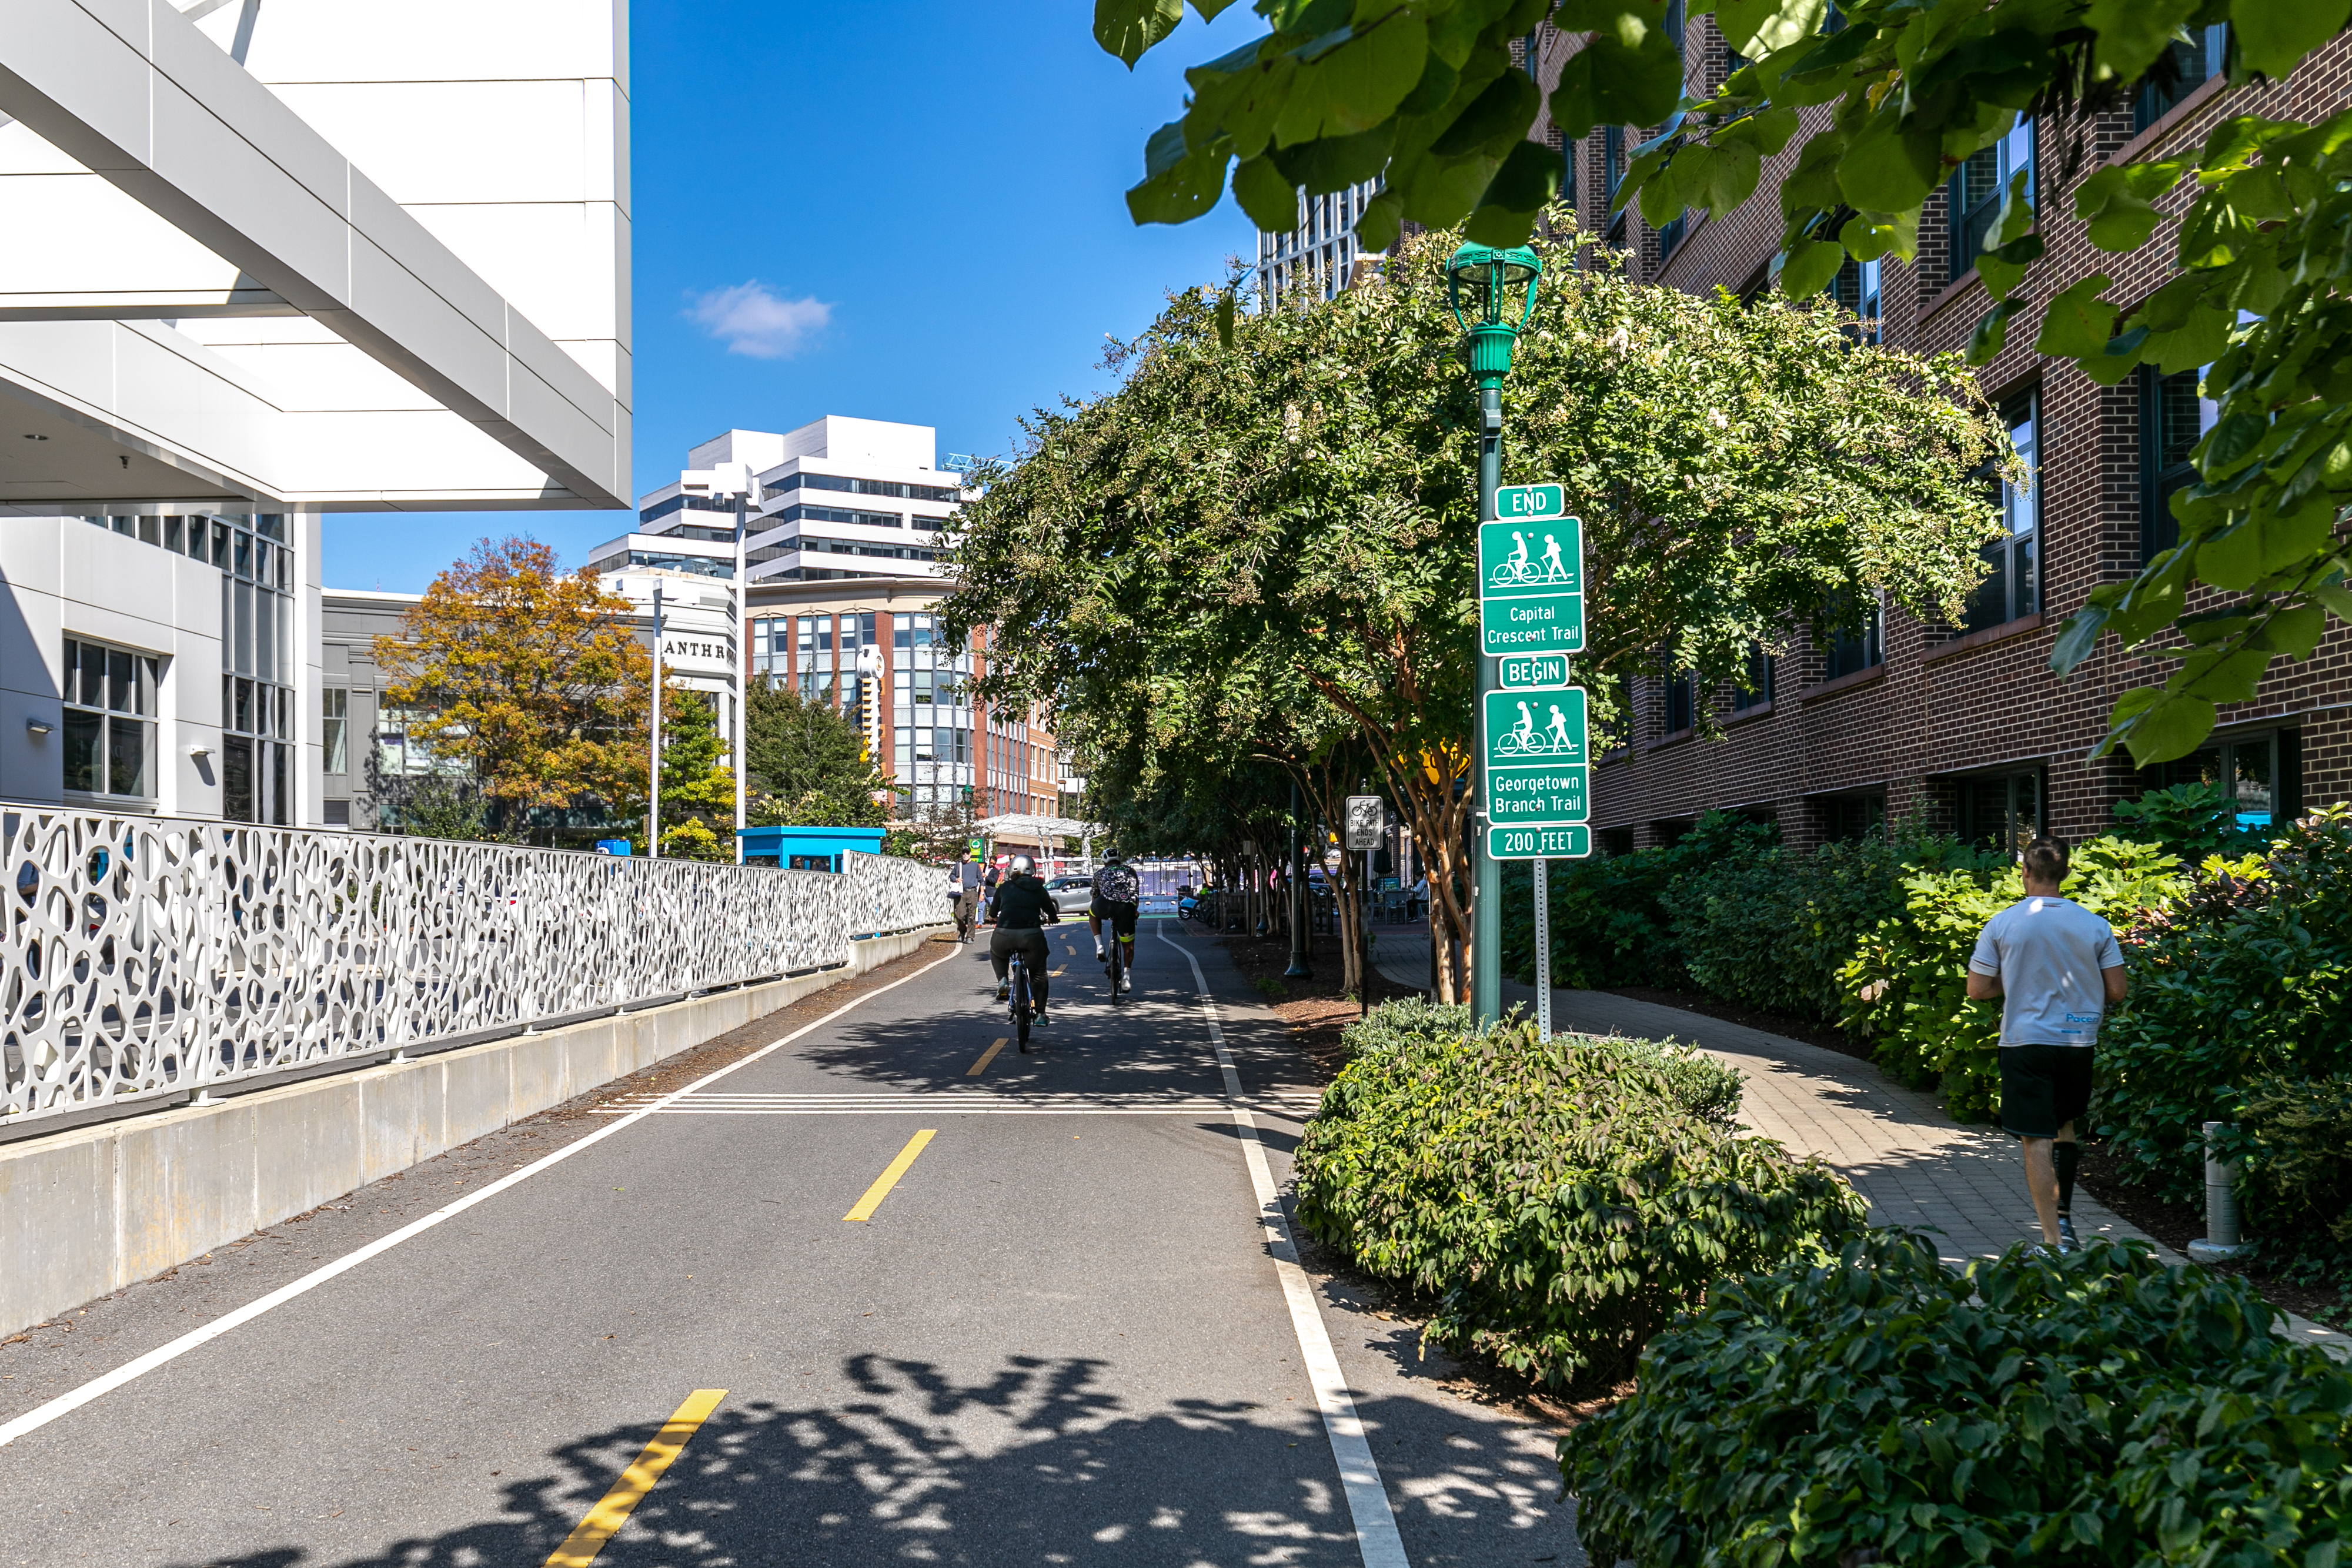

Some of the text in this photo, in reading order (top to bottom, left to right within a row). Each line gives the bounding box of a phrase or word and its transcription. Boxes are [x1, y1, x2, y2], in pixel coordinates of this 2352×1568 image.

[1512, 492, 1546, 512] END
[1510, 606, 1555, 624] Capital
[1488, 626, 1579, 644] Crescent Trail
[1509, 661, 1560, 682] BEGIN
[1495, 775, 1579, 795] Georgetown
[1495, 795, 1581, 813] Branch Trail
[1504, 831, 1573, 852] 200 FEET
